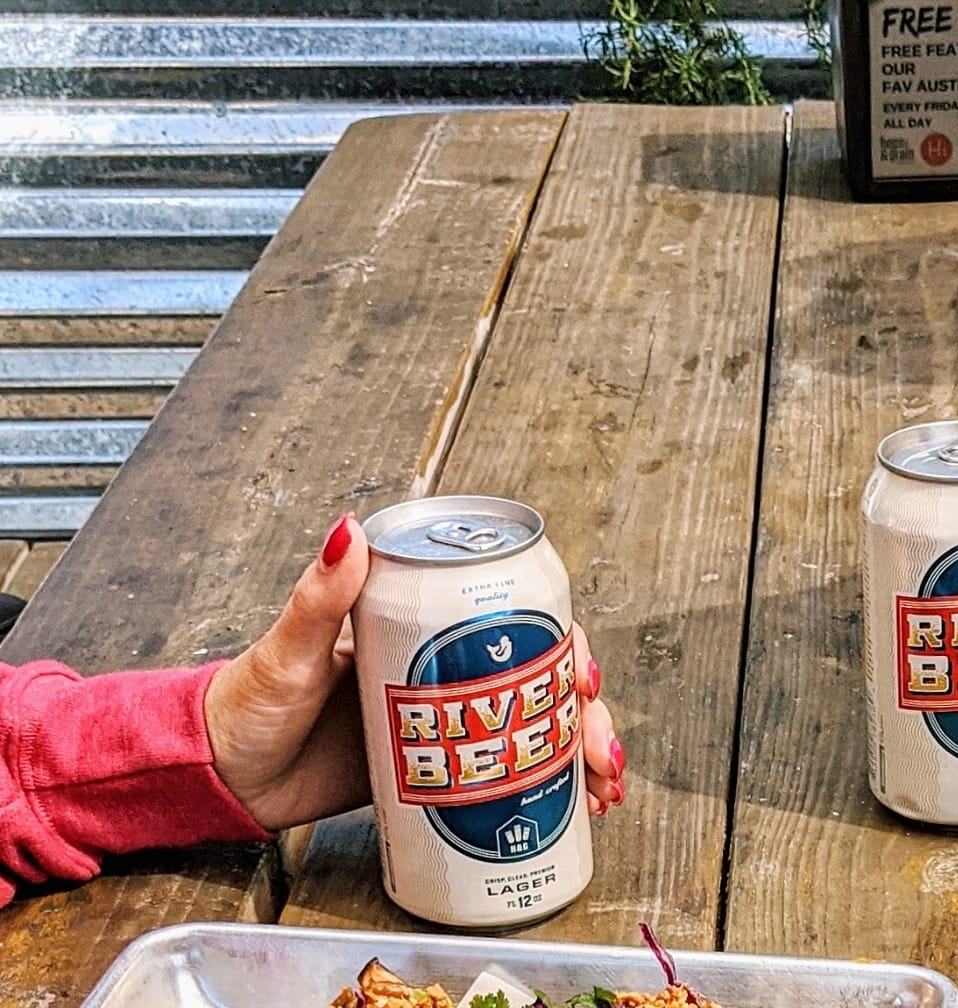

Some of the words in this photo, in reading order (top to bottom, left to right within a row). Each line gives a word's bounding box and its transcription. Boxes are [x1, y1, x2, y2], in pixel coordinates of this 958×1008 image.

[881, 8, 953, 38] FREE
[882, 45, 921, 58] FREE
[882, 62, 915, 76] OUR
[882, 81, 911, 93] FAV
[883, 101, 921, 113] EVERY
[884, 117, 906, 129] ALL
[908, 117, 932, 128] DAY
[474, 591, 509, 606] quality
[397, 647, 575, 739] RIVER
[402, 690, 579, 787] BEER
[487, 873, 556, 896] LAGER
[518, 894, 533, 908] 12
